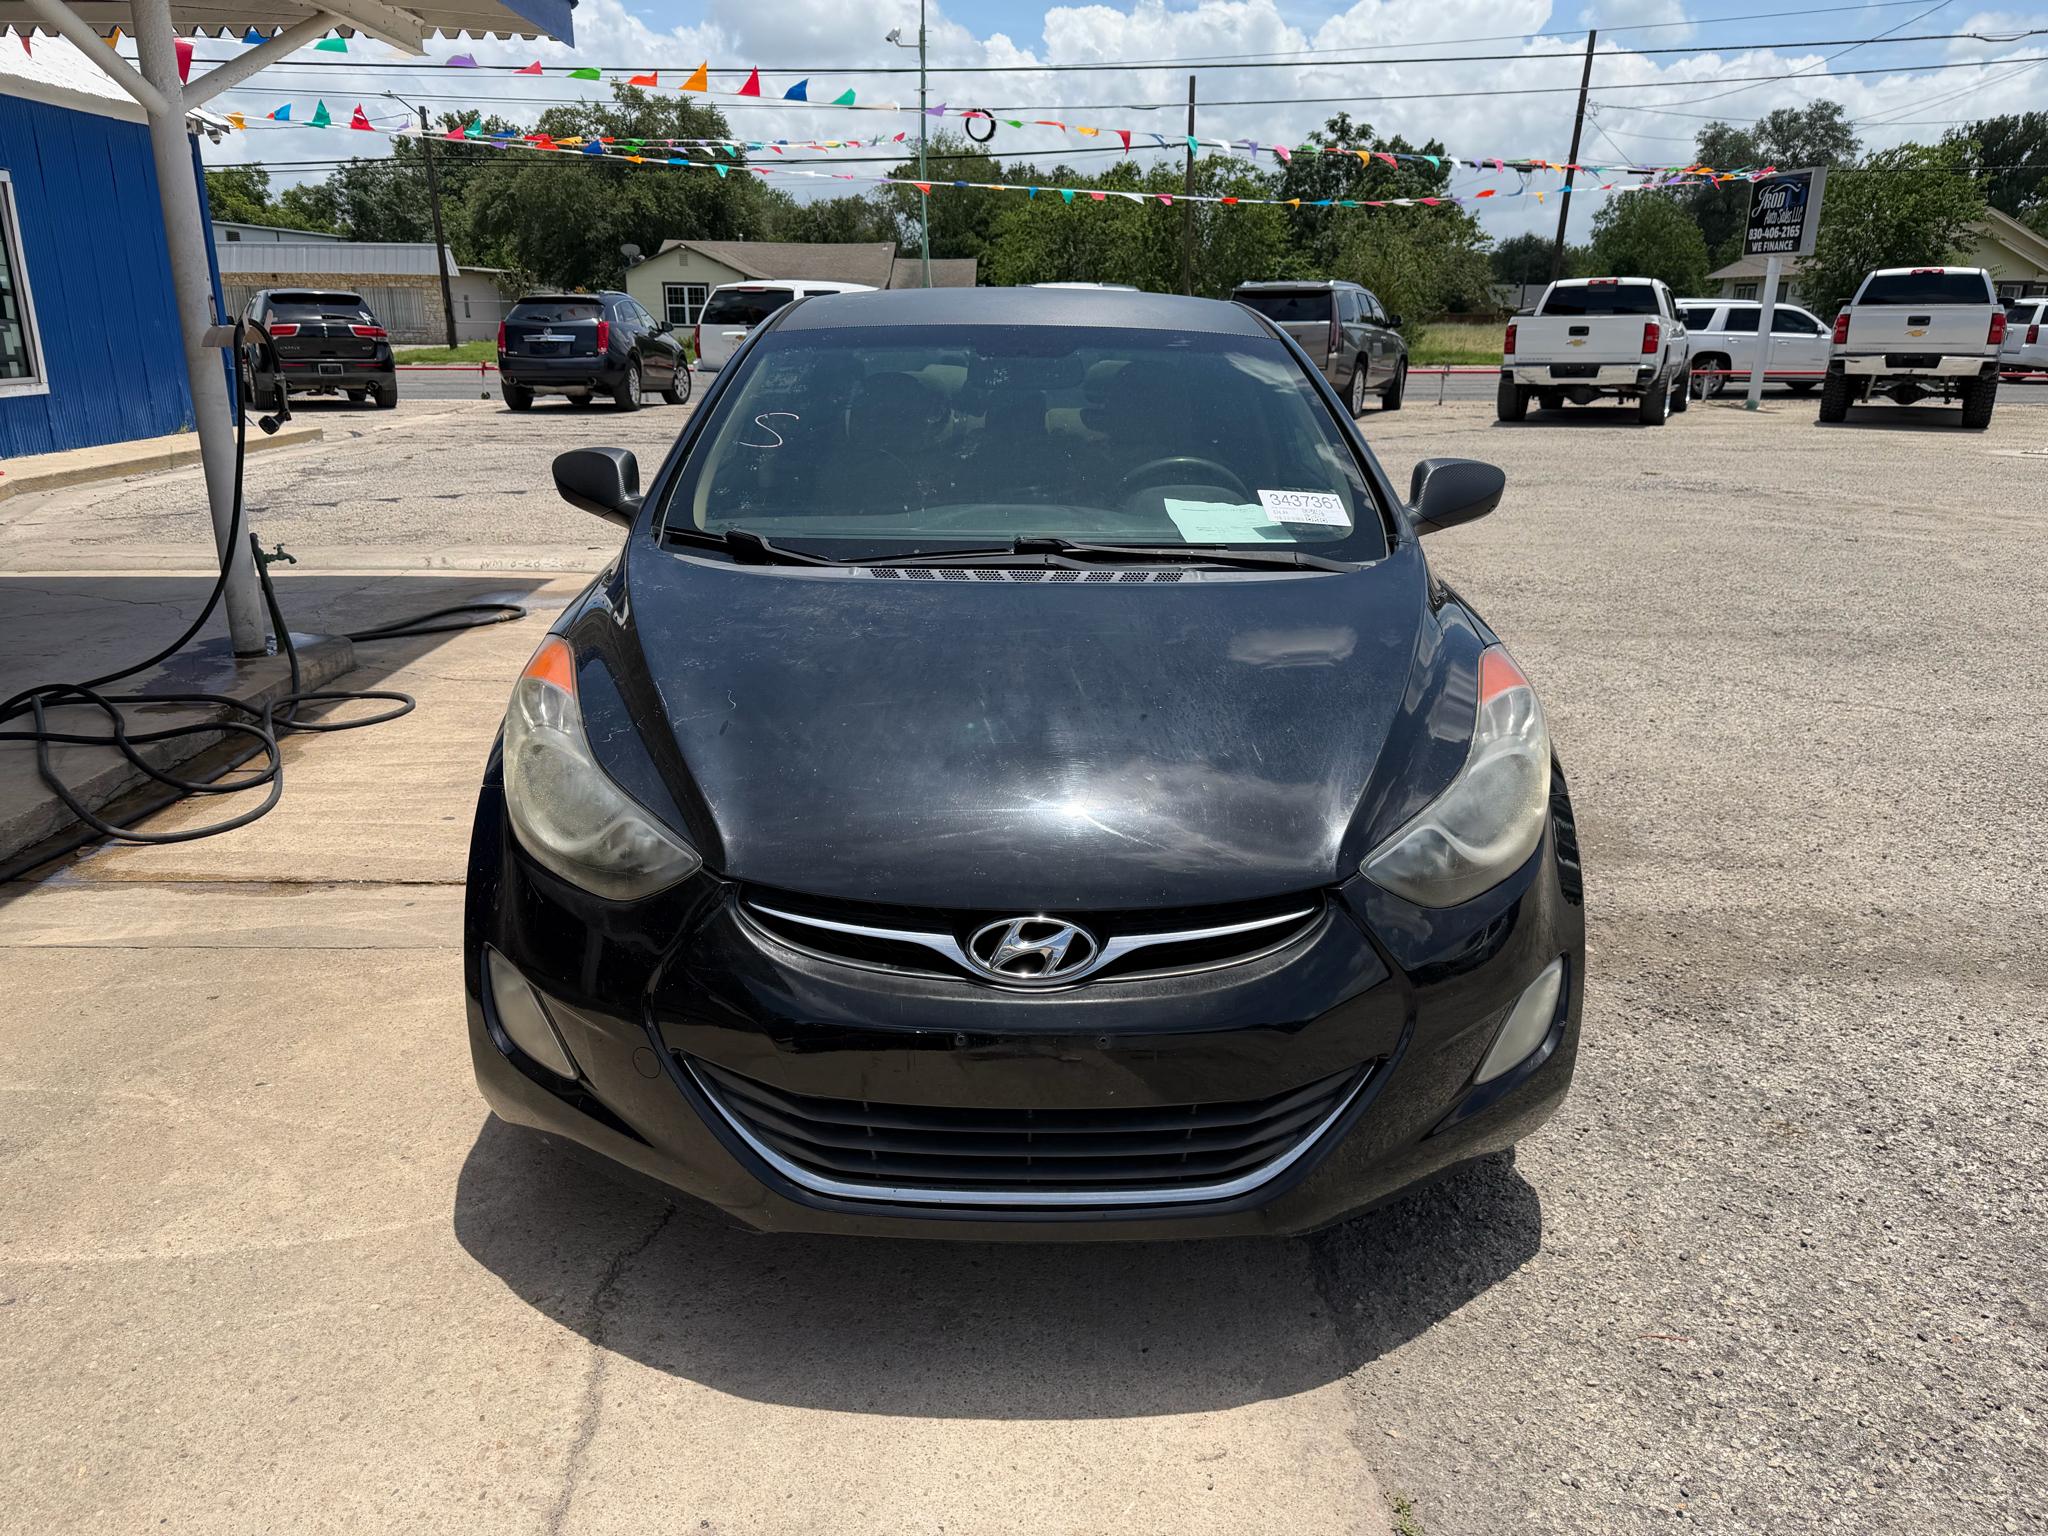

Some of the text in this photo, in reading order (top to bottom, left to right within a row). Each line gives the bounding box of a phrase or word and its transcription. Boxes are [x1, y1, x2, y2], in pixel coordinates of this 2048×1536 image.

[1763, 206, 1803, 225] Auto Sales LLC
[1748, 225, 1800, 240] 830-406-2165
[1752, 240, 1793, 252] WE FINANCE
[1269, 493, 1341, 510] 3437361
